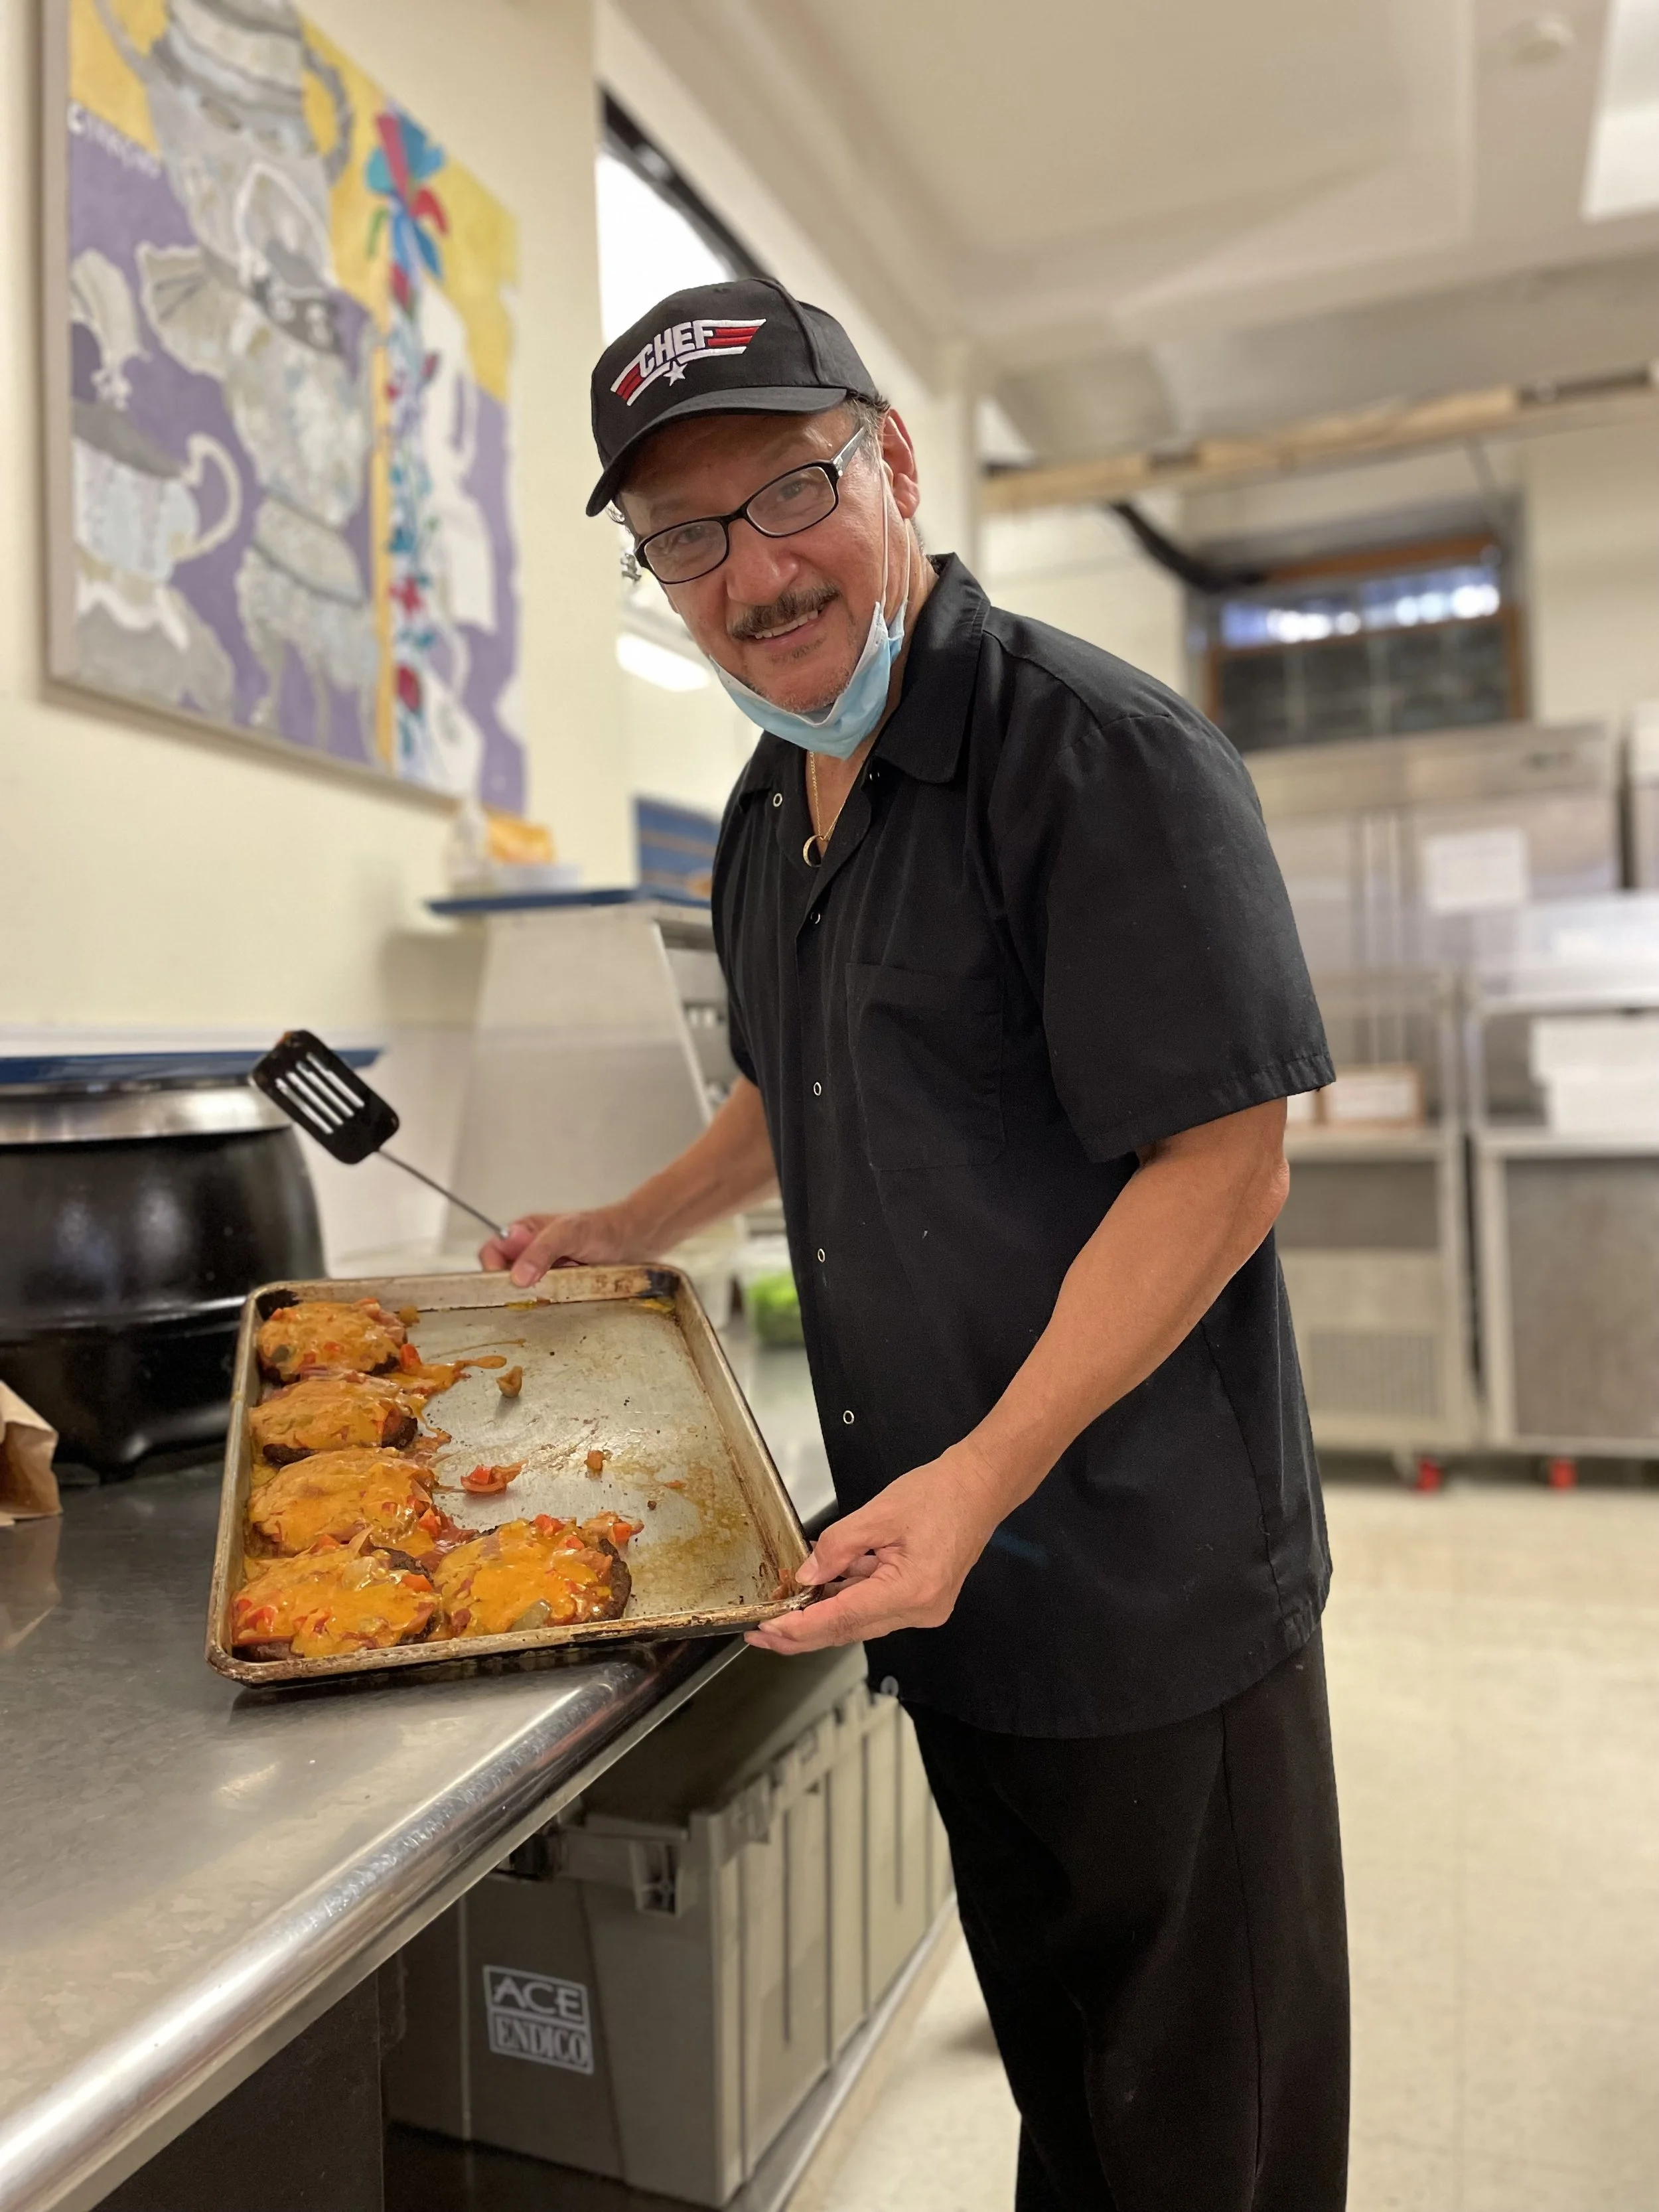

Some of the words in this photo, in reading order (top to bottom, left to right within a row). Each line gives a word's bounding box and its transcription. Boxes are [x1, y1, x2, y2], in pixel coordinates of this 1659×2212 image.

[638, 319, 714, 378] CHEF
[494, 1976, 583, 2022] ACE
[496, 2016, 589, 2065] ENDICO
